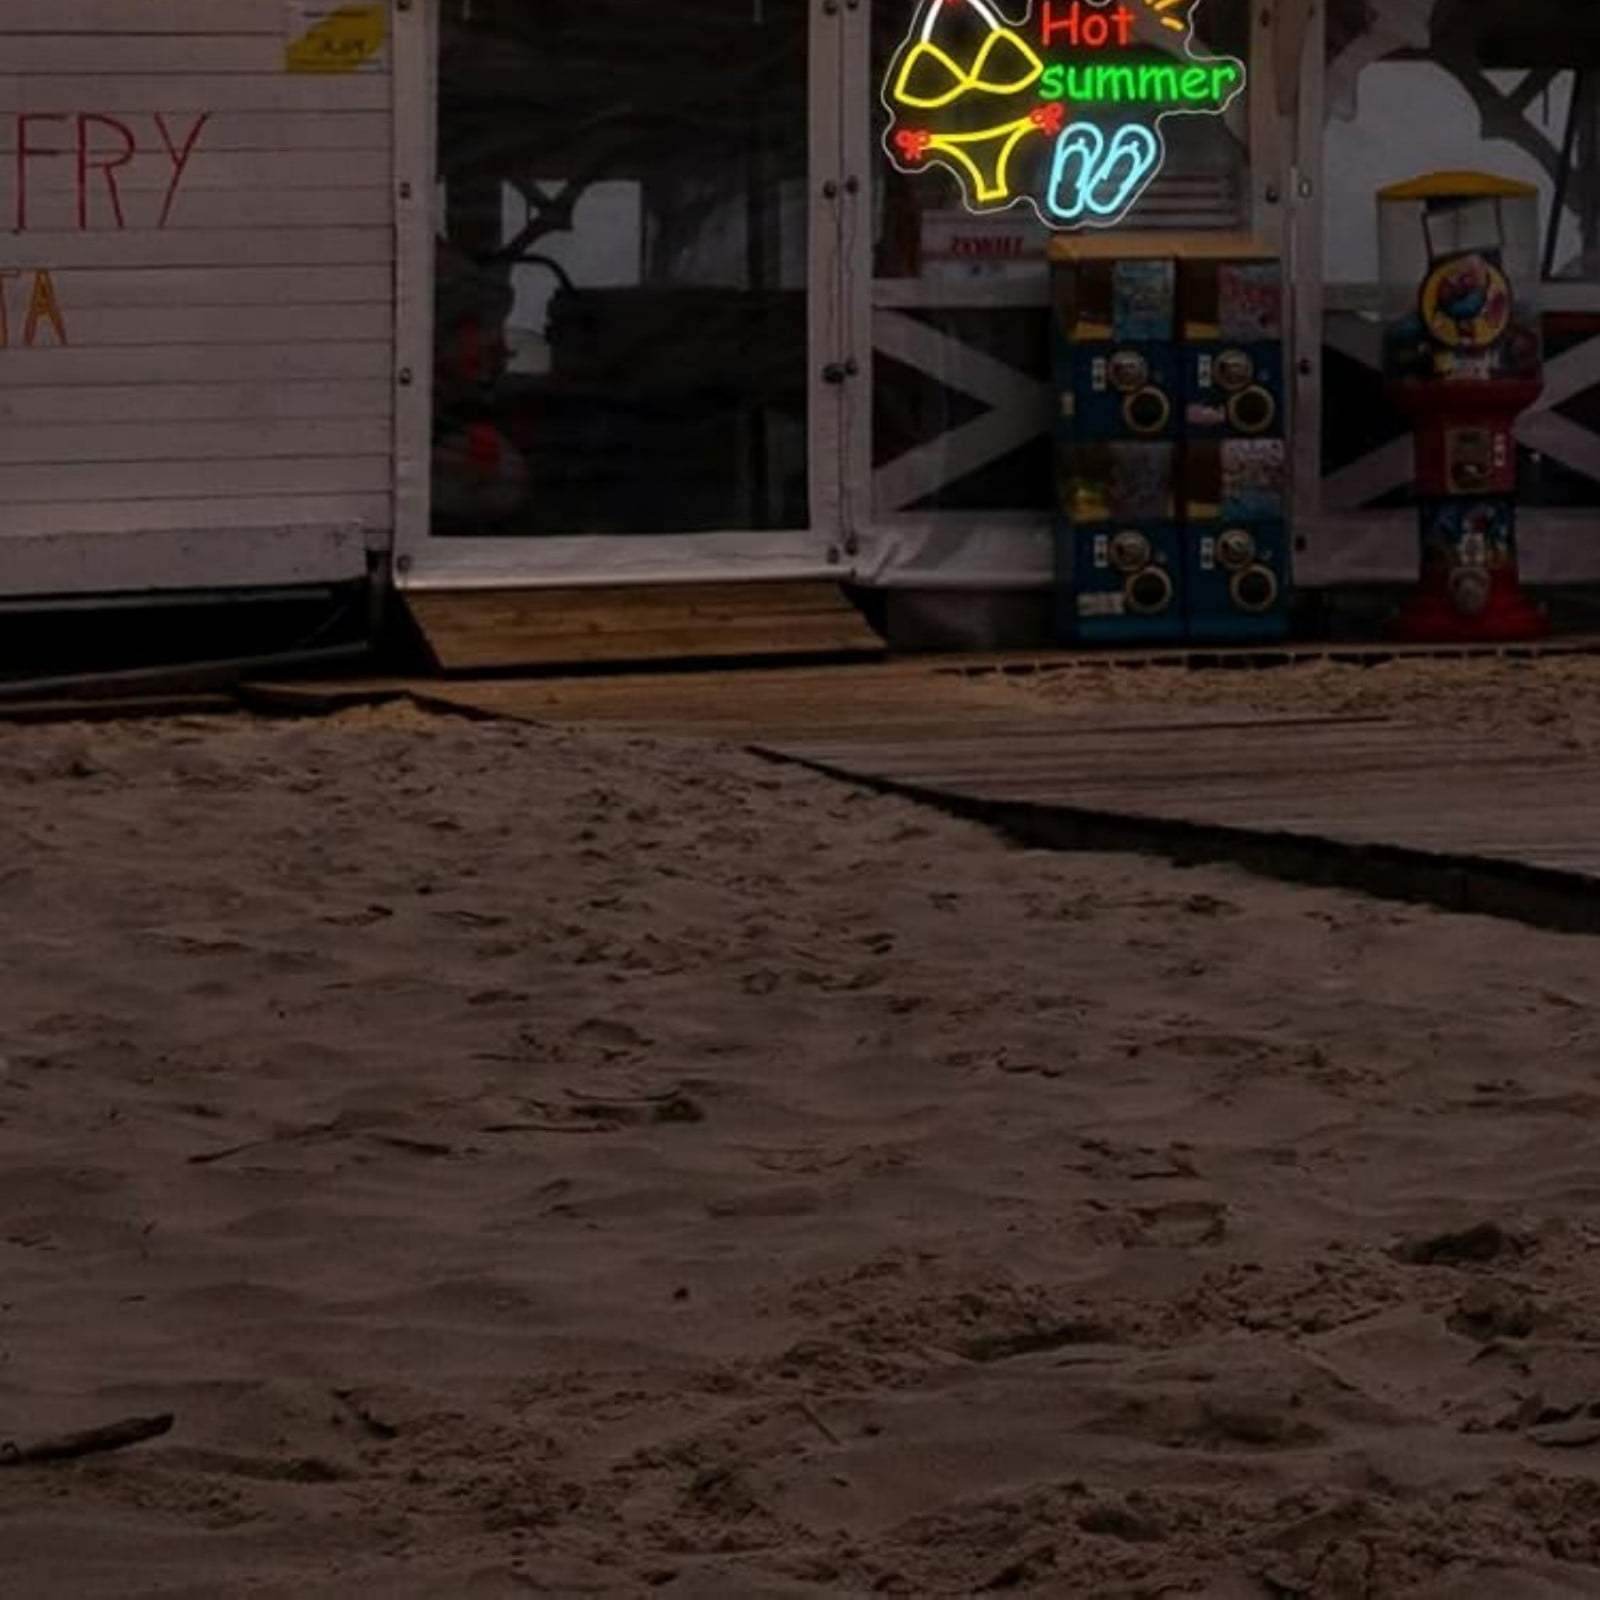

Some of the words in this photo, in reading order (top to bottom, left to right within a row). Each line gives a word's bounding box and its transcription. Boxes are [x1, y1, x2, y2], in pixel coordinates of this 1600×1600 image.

[1041, 0, 1134, 46] Hot
[1038, 63, 1236, 100] summer
[15, 111, 212, 232] FRY
